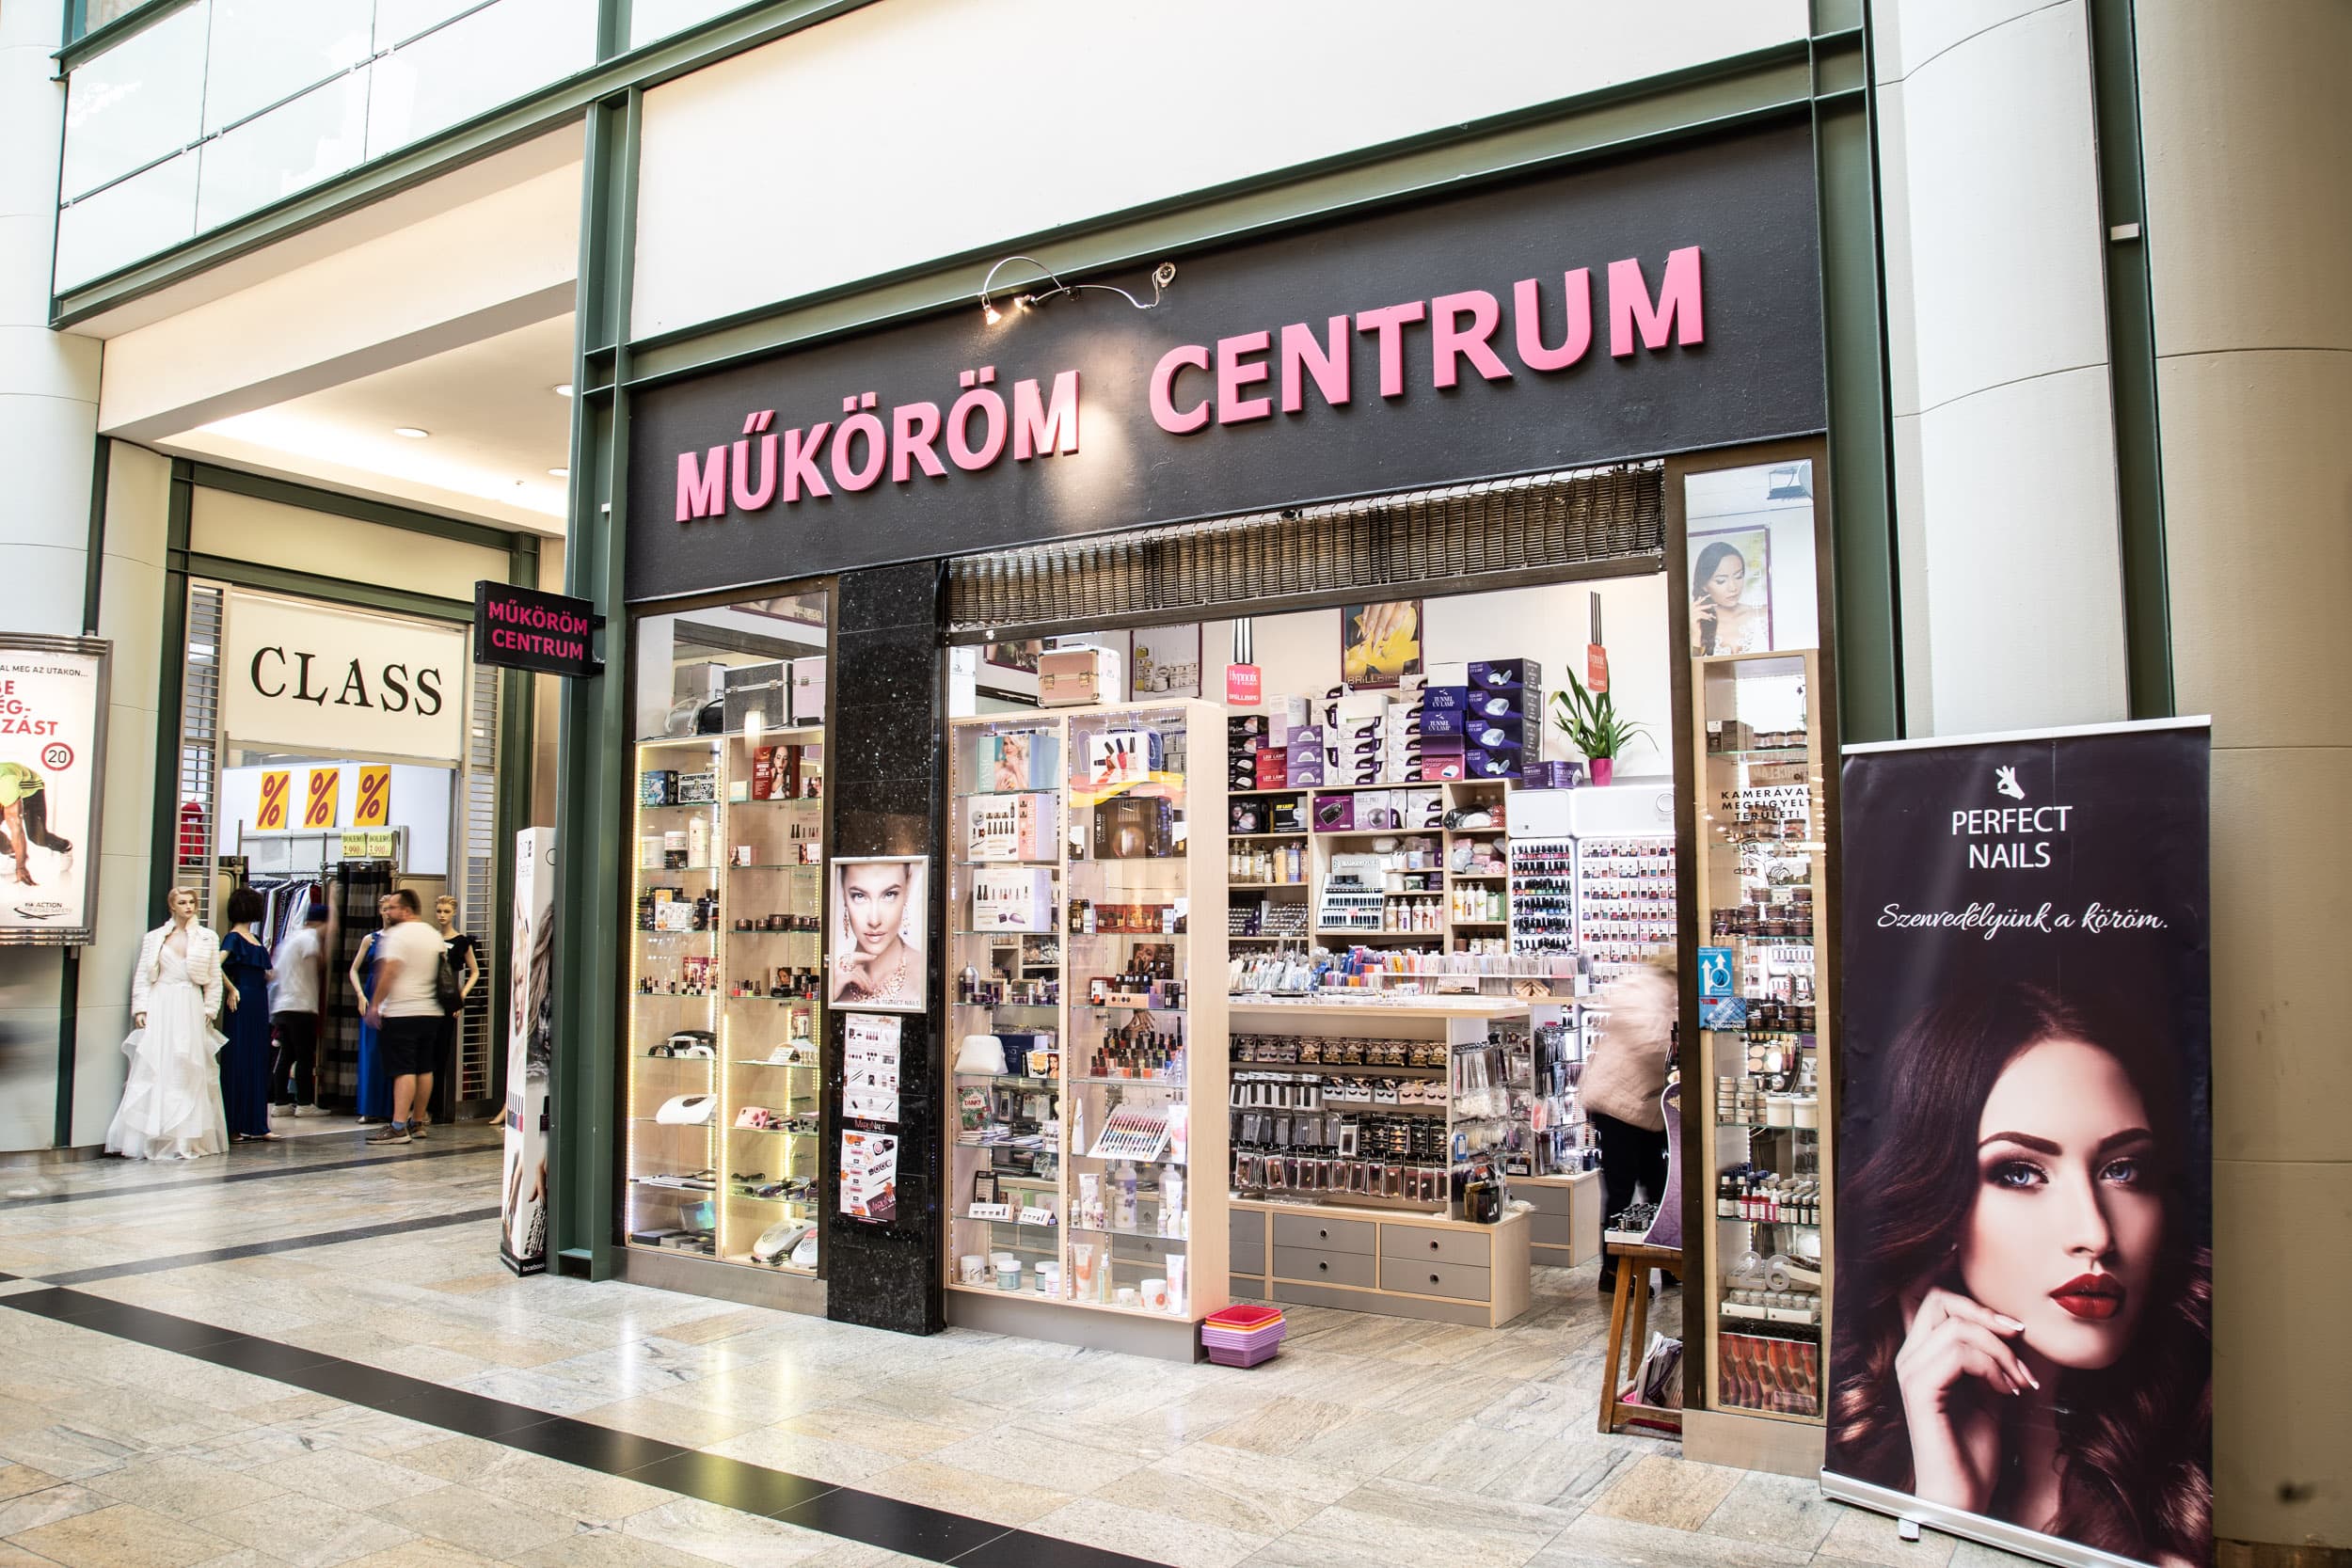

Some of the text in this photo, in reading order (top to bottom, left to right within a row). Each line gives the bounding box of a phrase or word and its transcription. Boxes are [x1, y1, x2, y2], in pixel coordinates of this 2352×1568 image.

[675, 245, 1706, 523] MŰKÖRÖM CENTRUM
[488, 598, 588, 637] MŰKÖRÖM
[492, 629, 583, 660] CENTRUM
[0, 679, 15, 695] E
[251, 646, 443, 717] CLASS
[48, 750, 67, 764] 20
[1722, 786, 1813, 800] KAMERÁVAL
[1722, 799, 1813, 810] MEGFIGYELT
[1735, 809, 1800, 819] TERÜLET!
[1952, 805, 2073, 835] PERFECT
[1968, 842, 2051, 869] NAILS
[1877, 901, 2169, 940] Szenvedélyünk a köröm.
